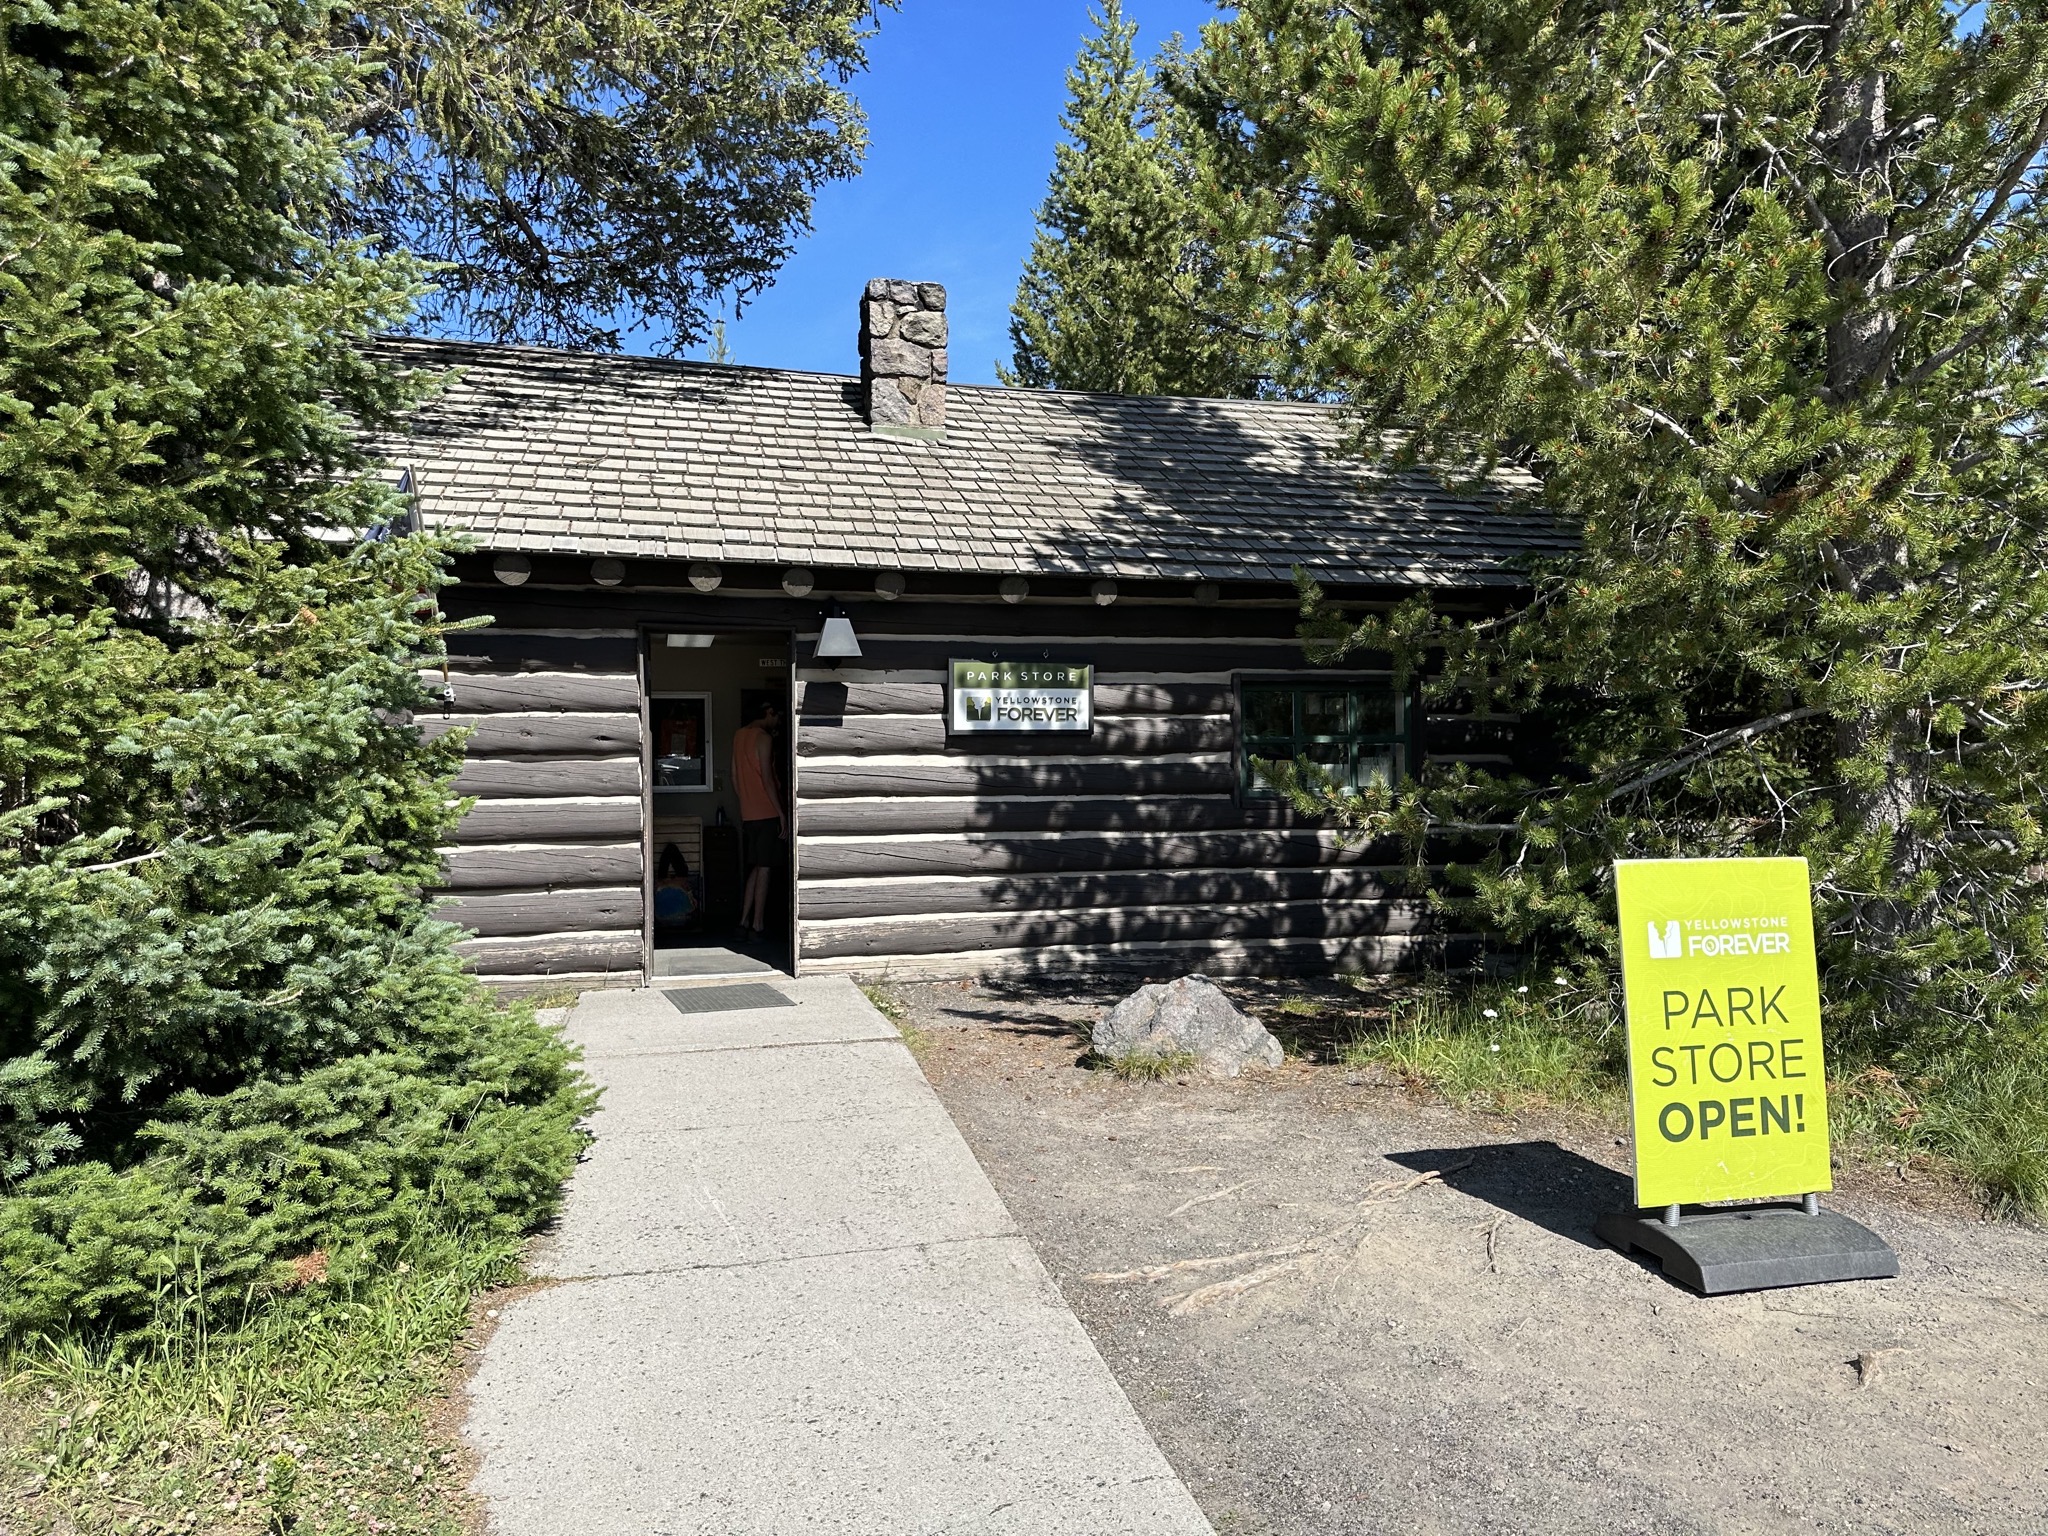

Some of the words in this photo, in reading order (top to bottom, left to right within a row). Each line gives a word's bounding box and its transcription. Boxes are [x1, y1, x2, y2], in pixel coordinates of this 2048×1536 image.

[966, 671, 1012, 681] PARK
[1020, 671, 1077, 682] STORE
[995, 696, 1077, 704] YELLOWSTONE
[997, 707, 1077, 722] FOREVER
[1684, 917, 1788, 931] YELLOWSTONE
[1688, 933, 1790, 957] FOREVER
[1663, 985, 1789, 1030] PARK
[1651, 1039, 1806, 1087] STORE
[1658, 1093, 1805, 1143] OPEN!
